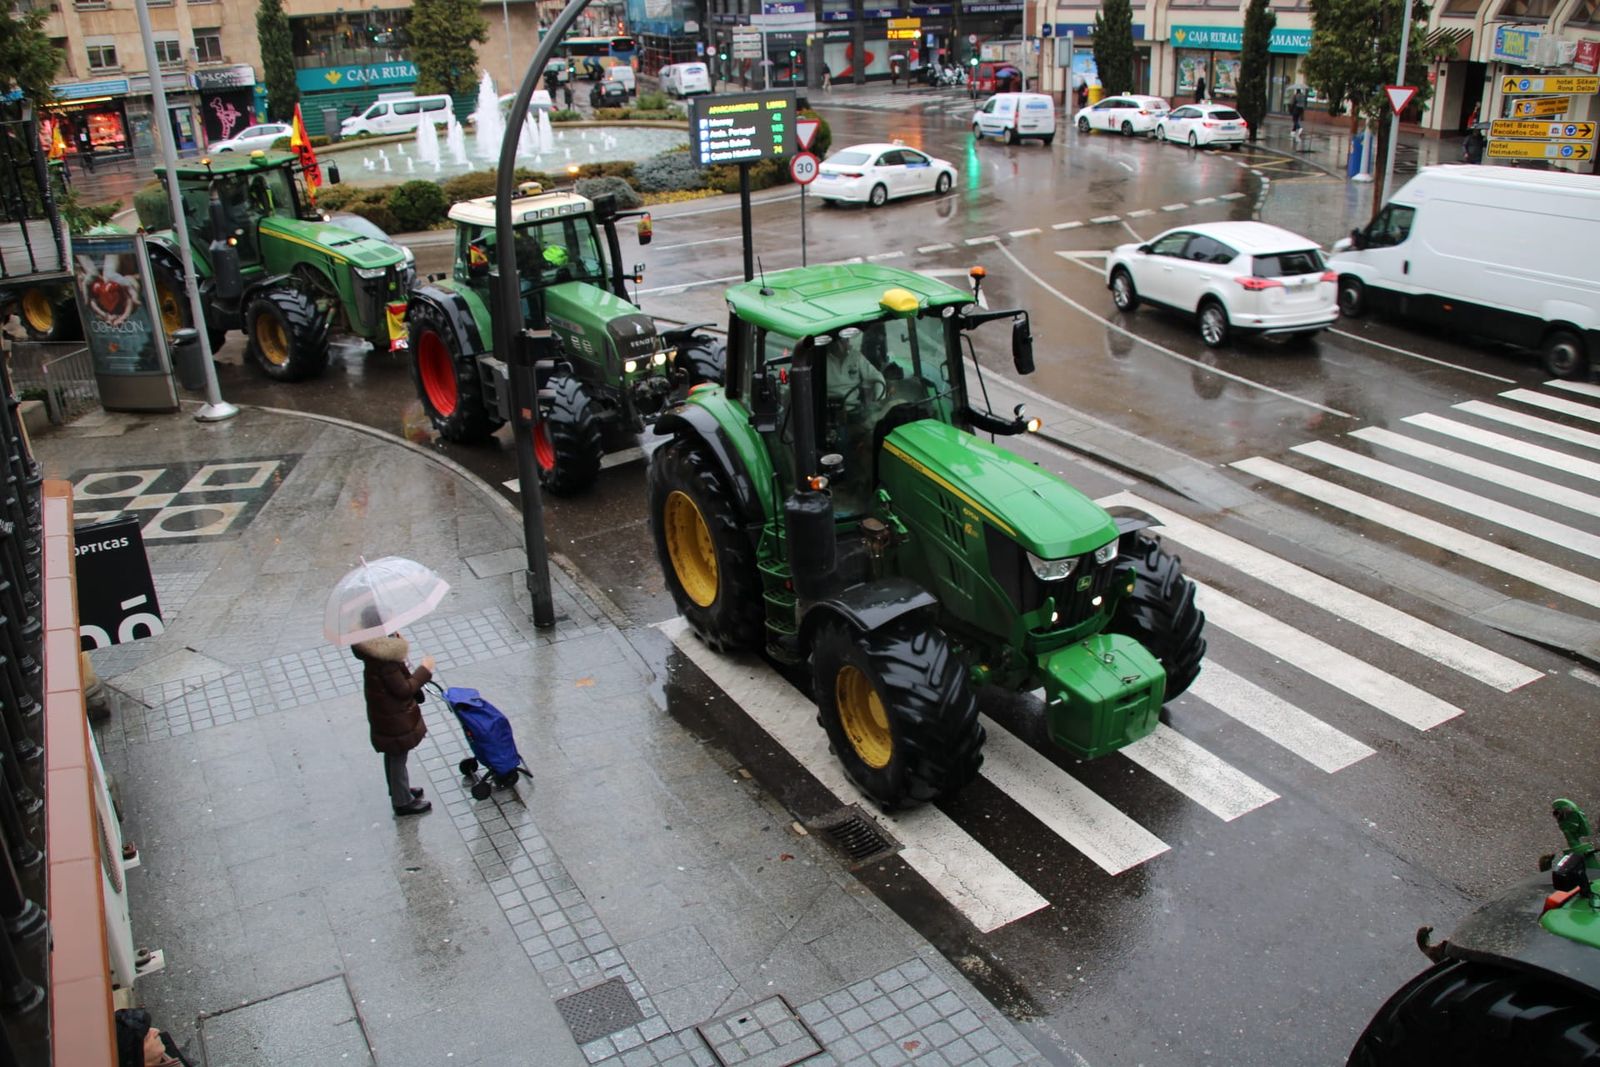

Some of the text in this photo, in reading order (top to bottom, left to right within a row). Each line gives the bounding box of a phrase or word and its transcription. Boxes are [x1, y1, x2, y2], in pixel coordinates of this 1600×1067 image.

[1188, 30, 1208, 44] CAJA
[1210, 32, 1237, 43] RURAL
[346, 65, 419, 82] CAJA RURA
[797, 162, 813, 174] 30
